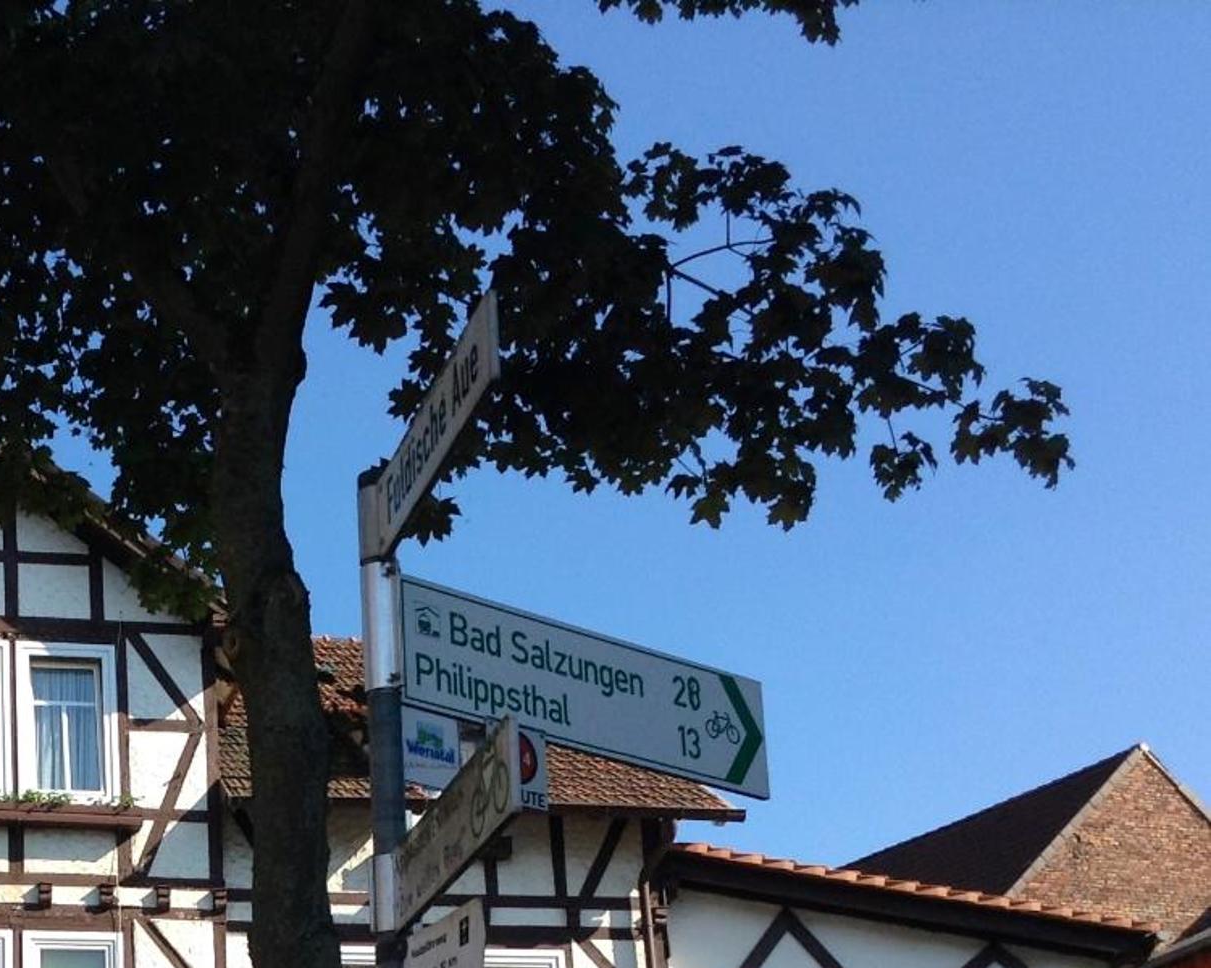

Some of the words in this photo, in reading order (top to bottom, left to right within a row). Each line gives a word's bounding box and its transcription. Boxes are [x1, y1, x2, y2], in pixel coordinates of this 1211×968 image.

[387, 393, 447, 524] Fuldische
[452, 343, 479, 416] Aue
[415, 652, 571, 726] Philippsthal
[677, 725, 702, 760] 13
[449, 611, 501, 658] Bad
[511, 630, 645, 698] Salzungen
[672, 675, 702, 711] 28
[521, 788, 546, 808] UTE
